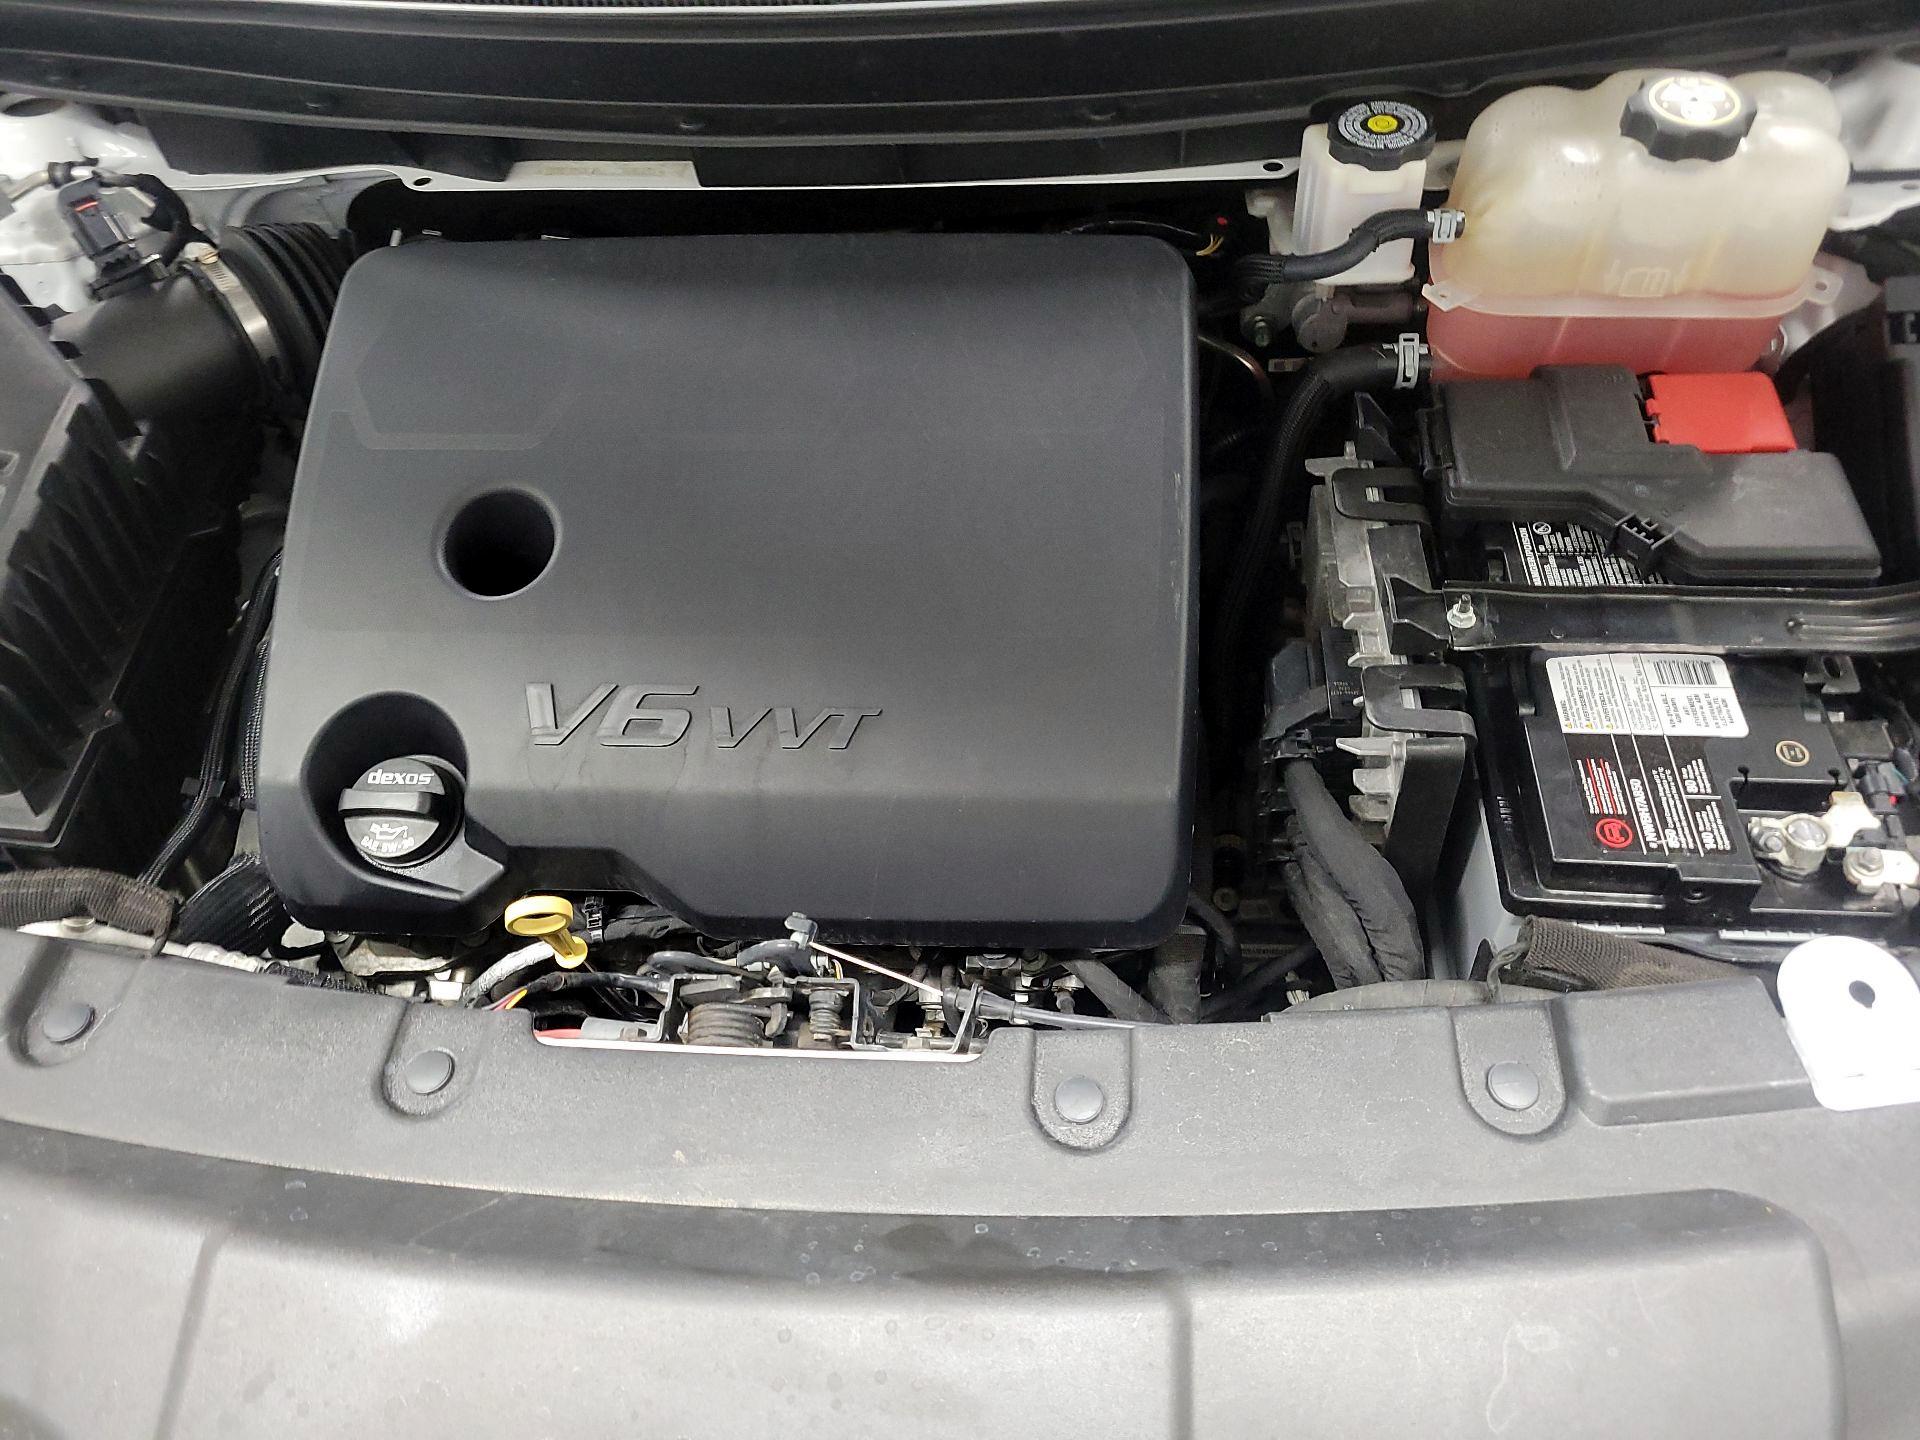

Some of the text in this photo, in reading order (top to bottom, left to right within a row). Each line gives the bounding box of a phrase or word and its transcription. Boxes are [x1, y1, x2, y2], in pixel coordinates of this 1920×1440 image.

[525, 681, 882, 749] V6 VVT
[367, 768, 434, 785] dexos
